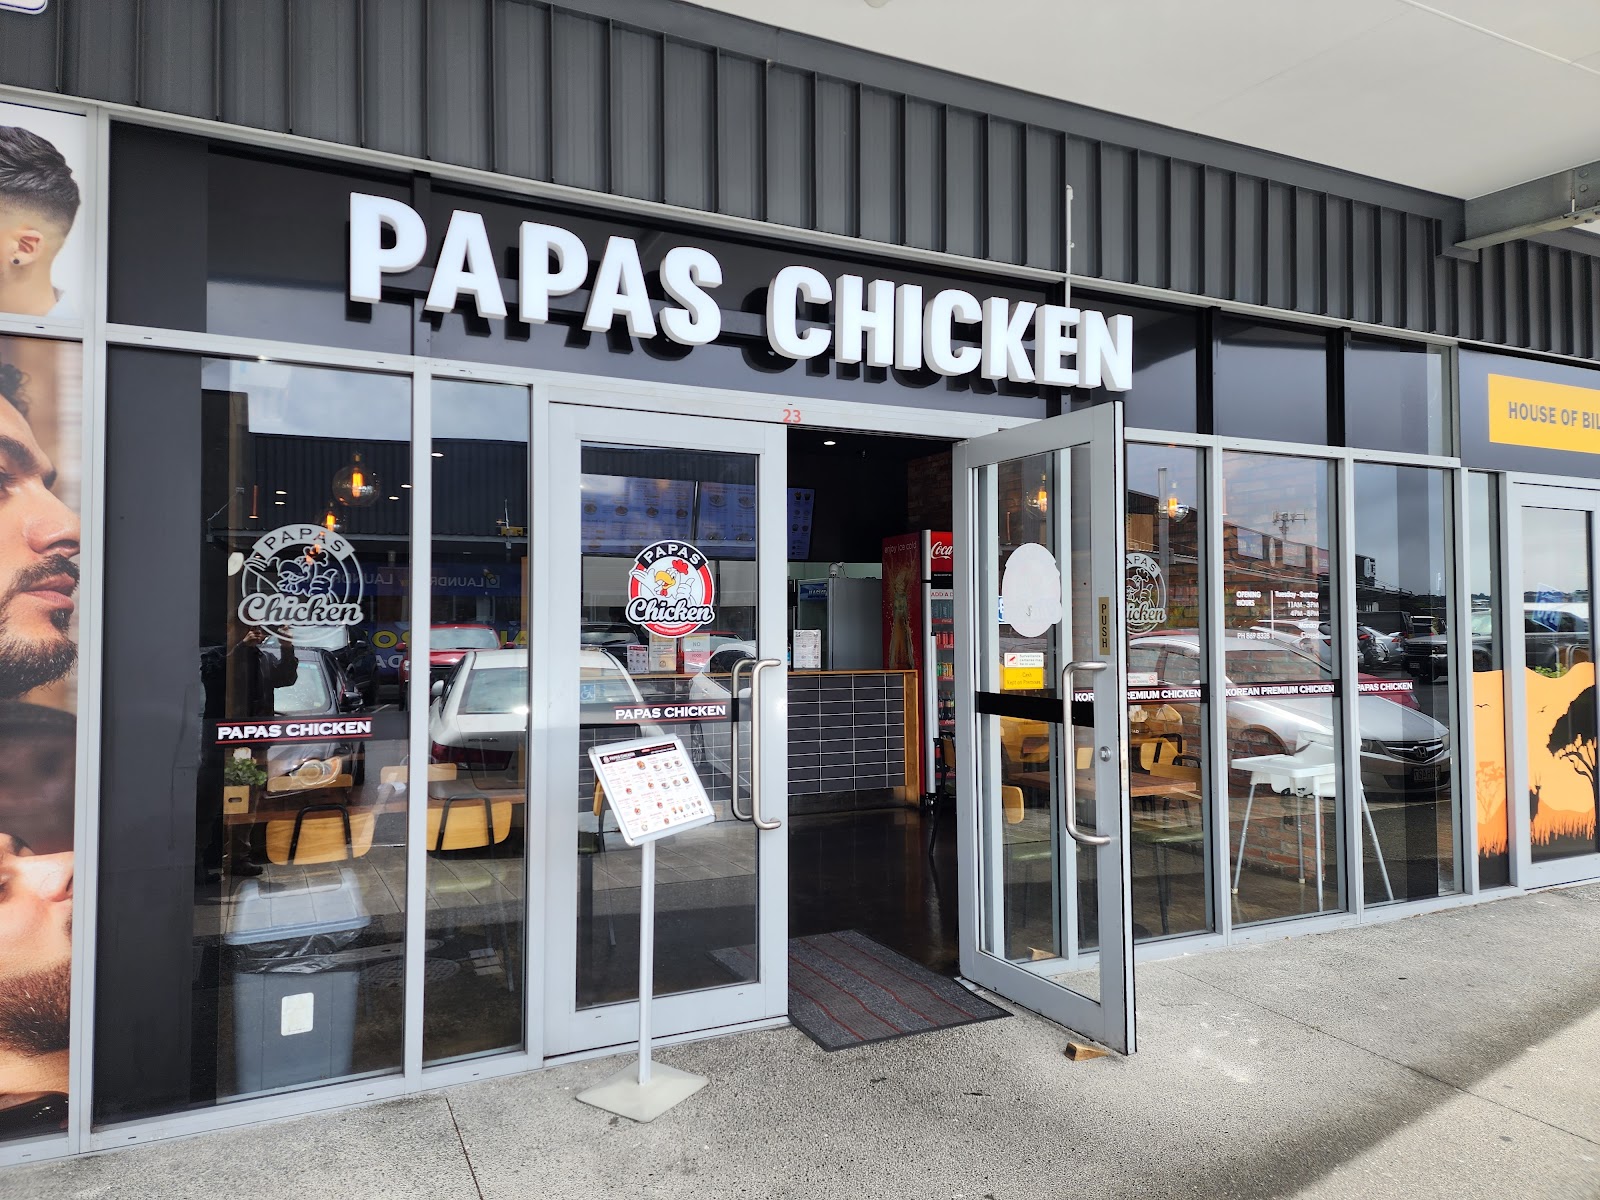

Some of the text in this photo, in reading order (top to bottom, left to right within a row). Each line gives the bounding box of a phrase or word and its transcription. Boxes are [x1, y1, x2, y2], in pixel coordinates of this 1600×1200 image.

[350, 192, 1133, 392] PAPAS CHICKEN
[783, 408, 802, 423] 23
[1508, 401, 1600, 430] HOUSE OF BIL
[263, 527, 345, 552] PAPAS
[884, 541, 917, 555] enjoy ice cold
[644, 544, 701, 565] PAPAS
[931, 541, 953, 559] Coca
[1126, 555, 1156, 572] APAS
[1275, 591, 1296, 599] Tuesday
[1300, 591, 1319, 599] Sunday
[240, 594, 362, 624] Chicken
[628, 598, 712, 623] Chicken
[1126, 601, 1164, 621] icken
[1127, 689, 1201, 700] EMIUM CHICKEN
[1226, 684, 1334, 696] KOREAN PREMIUM CHICKEN
[1357, 682, 1412, 692] PAPAS CHICKEN
[1075, 692, 1094, 702] KOR
[615, 705, 726, 720] PAPAS CHICKEN
[217, 721, 372, 740] PAPAS CHICKEN
